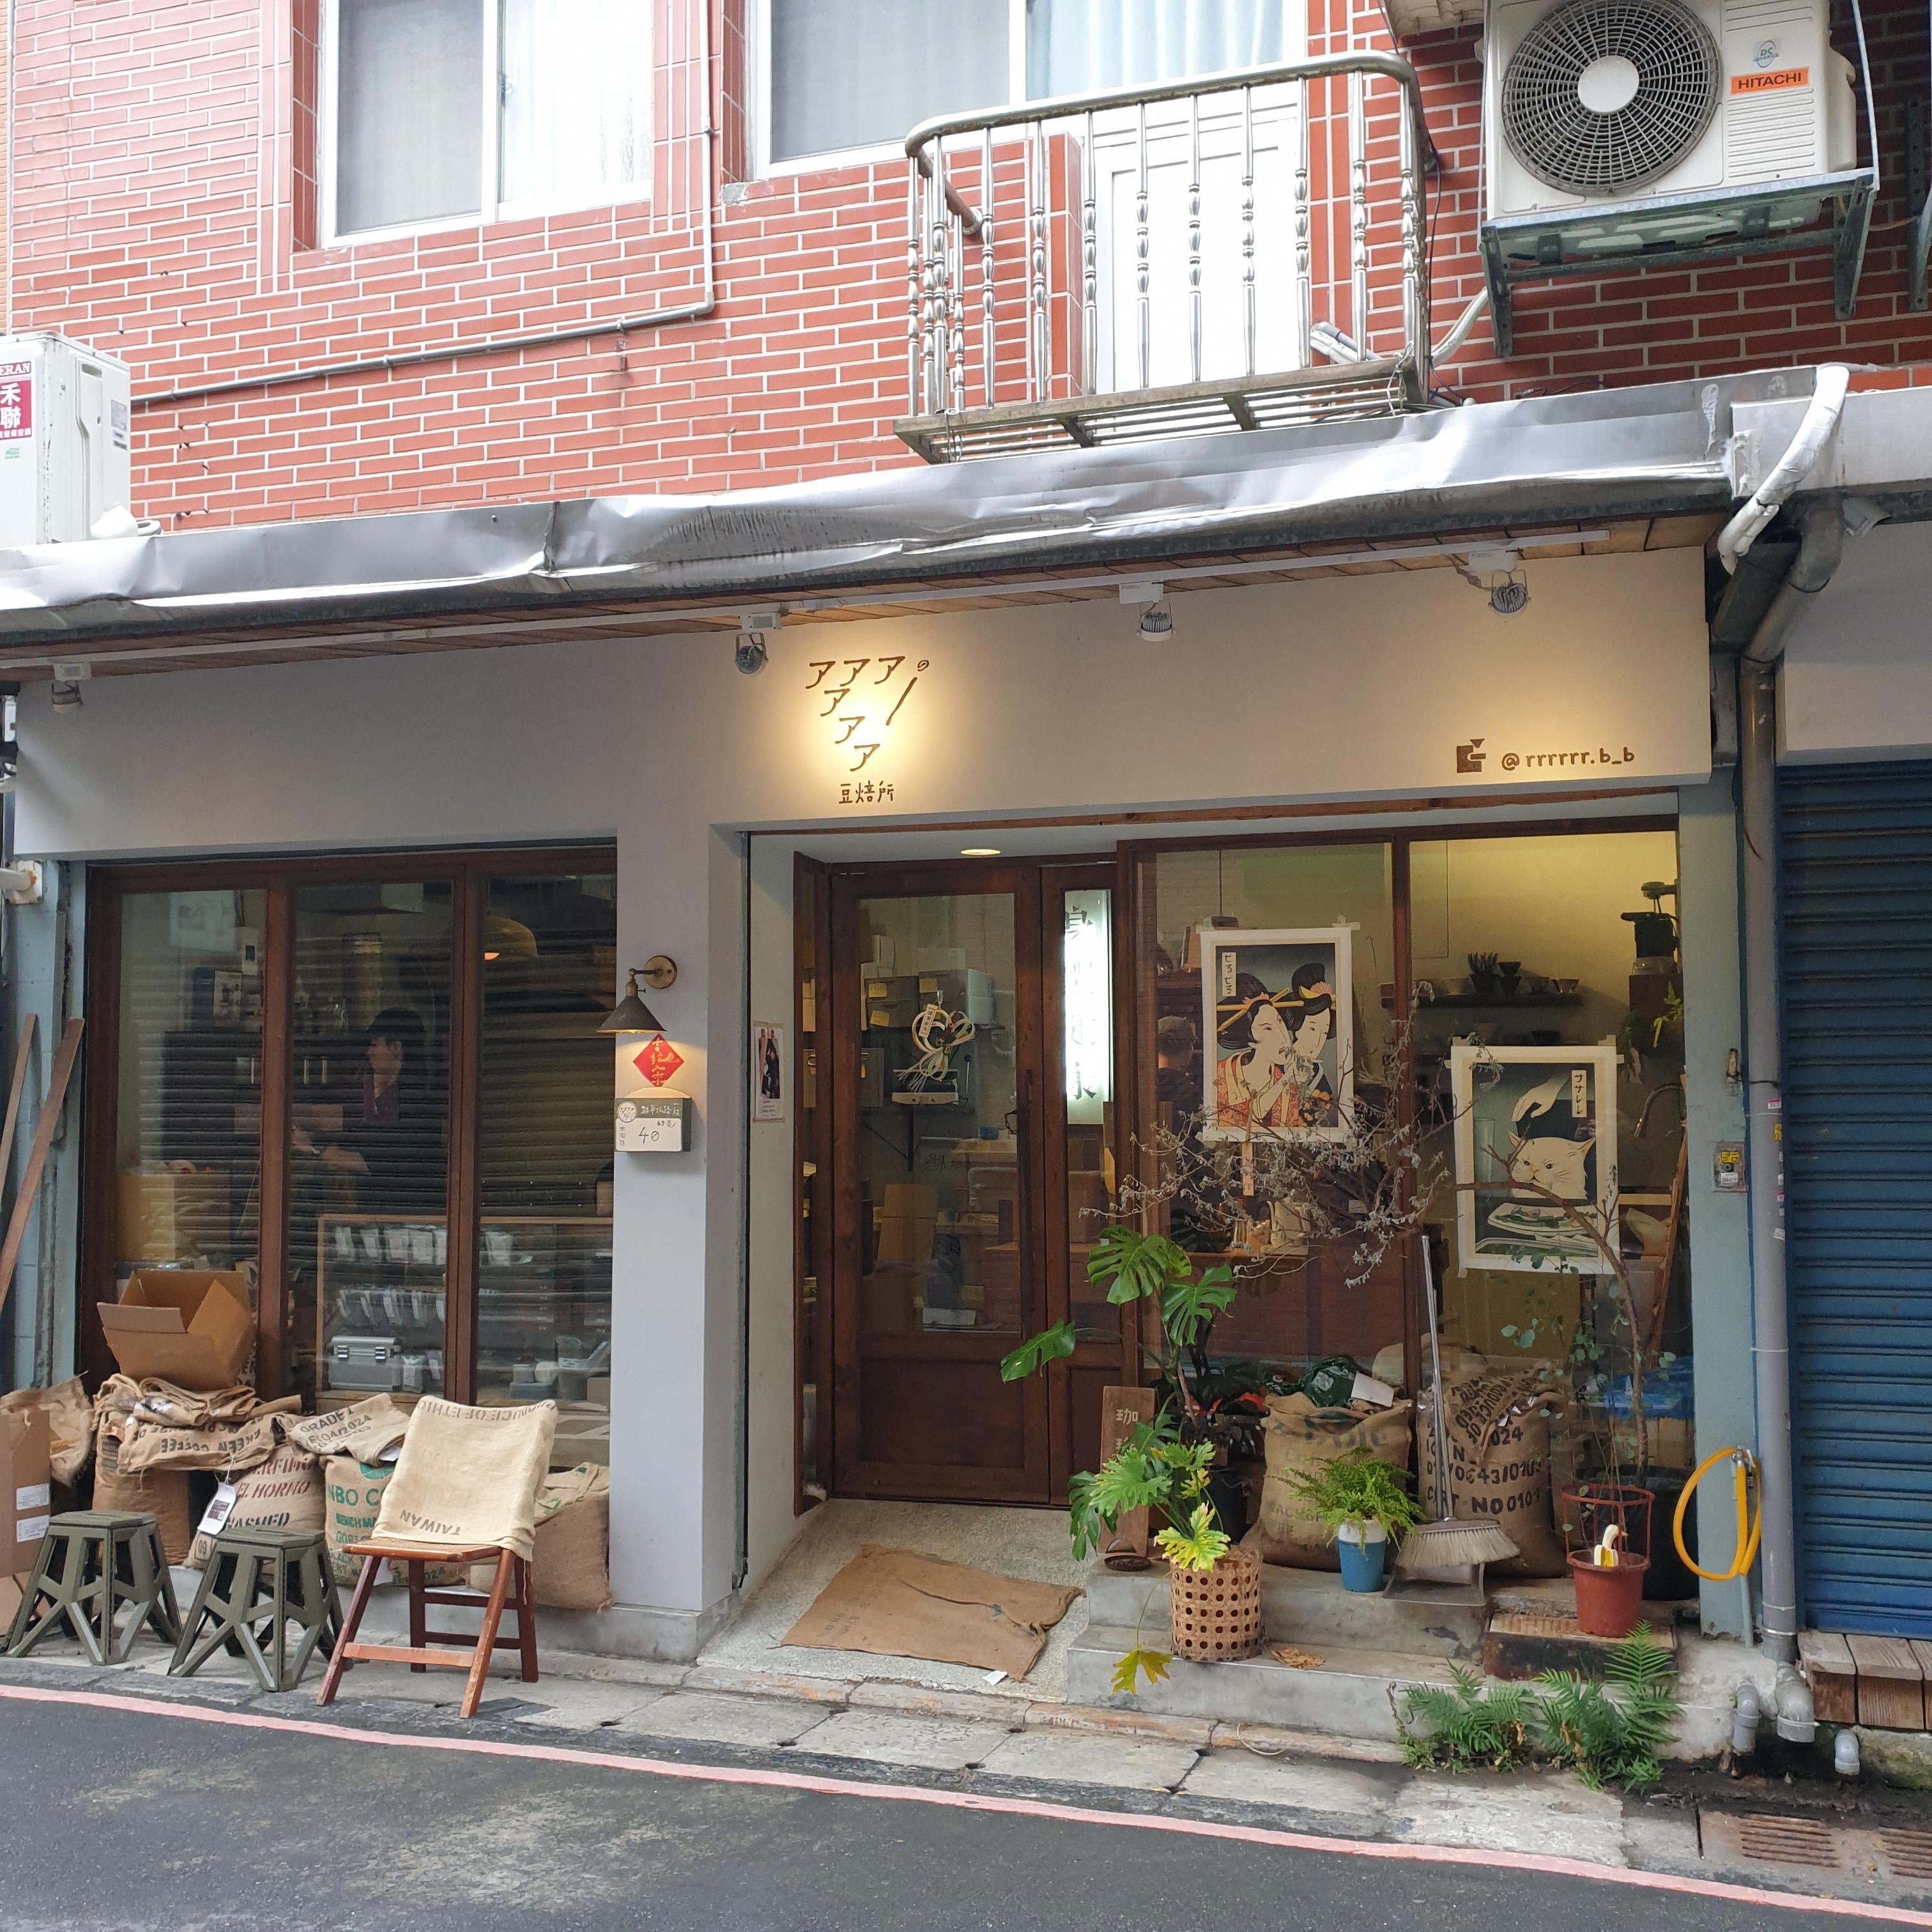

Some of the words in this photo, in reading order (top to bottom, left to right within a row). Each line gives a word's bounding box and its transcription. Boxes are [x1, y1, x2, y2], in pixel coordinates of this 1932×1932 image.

[1760, 47, 1774, 56] DC
[1737, 72, 1802, 89] HITACHI
[0, 382, 21, 429] 禾聯
[838, 779, 894, 804] 豆焙所
[464, 1409, 486, 1422] OF
[1486, 1426, 1524, 1447] 024
[399, 1508, 461, 1537] TAIWAN
